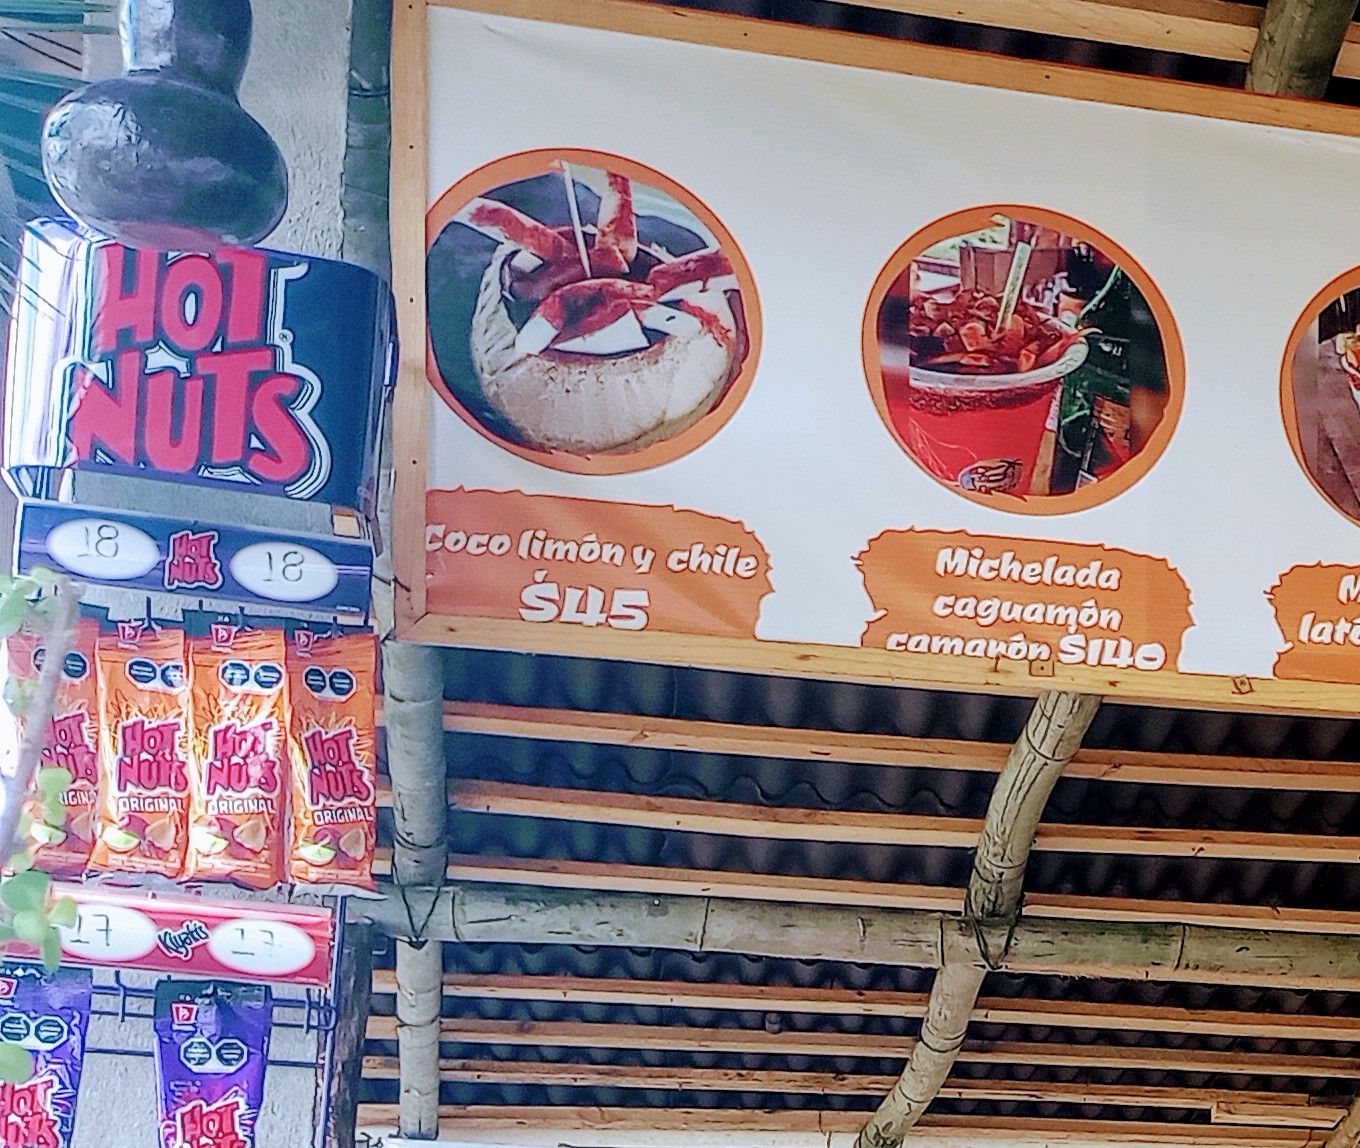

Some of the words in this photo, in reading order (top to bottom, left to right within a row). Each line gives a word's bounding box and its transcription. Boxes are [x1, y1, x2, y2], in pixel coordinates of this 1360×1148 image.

[98, 244, 270, 352] HOT
[69, 348, 310, 483] NUTS
[77, 516, 120, 560] 18
[170, 531, 216, 559] HOT
[426, 523, 511, 557] Coco
[518, 528, 626, 567] limón
[632, 545, 657, 574] y
[666, 543, 758, 578] chile
[166, 555, 220, 587] NUTS
[260, 549, 306, 583] 18
[935, 546, 1122, 592] Michelada
[519, 569, 650, 631] $45
[932, 594, 1123, 631] caguamón
[886, 632, 1051, 662] camarón
[1058, 624, 1168, 672] $140
[121, 718, 181, 757] HOT
[212, 719, 274, 758] HOT
[306, 727, 355, 767] HOT
[118, 753, 189, 792] NUTS
[310, 763, 372, 801] NUTS
[118, 796, 185, 814] ORIGINAL
[206, 797, 276, 816] ORIGINAL
[313, 808, 374, 826] ORIGINAL
[181, 1101, 241, 1143] HOT
